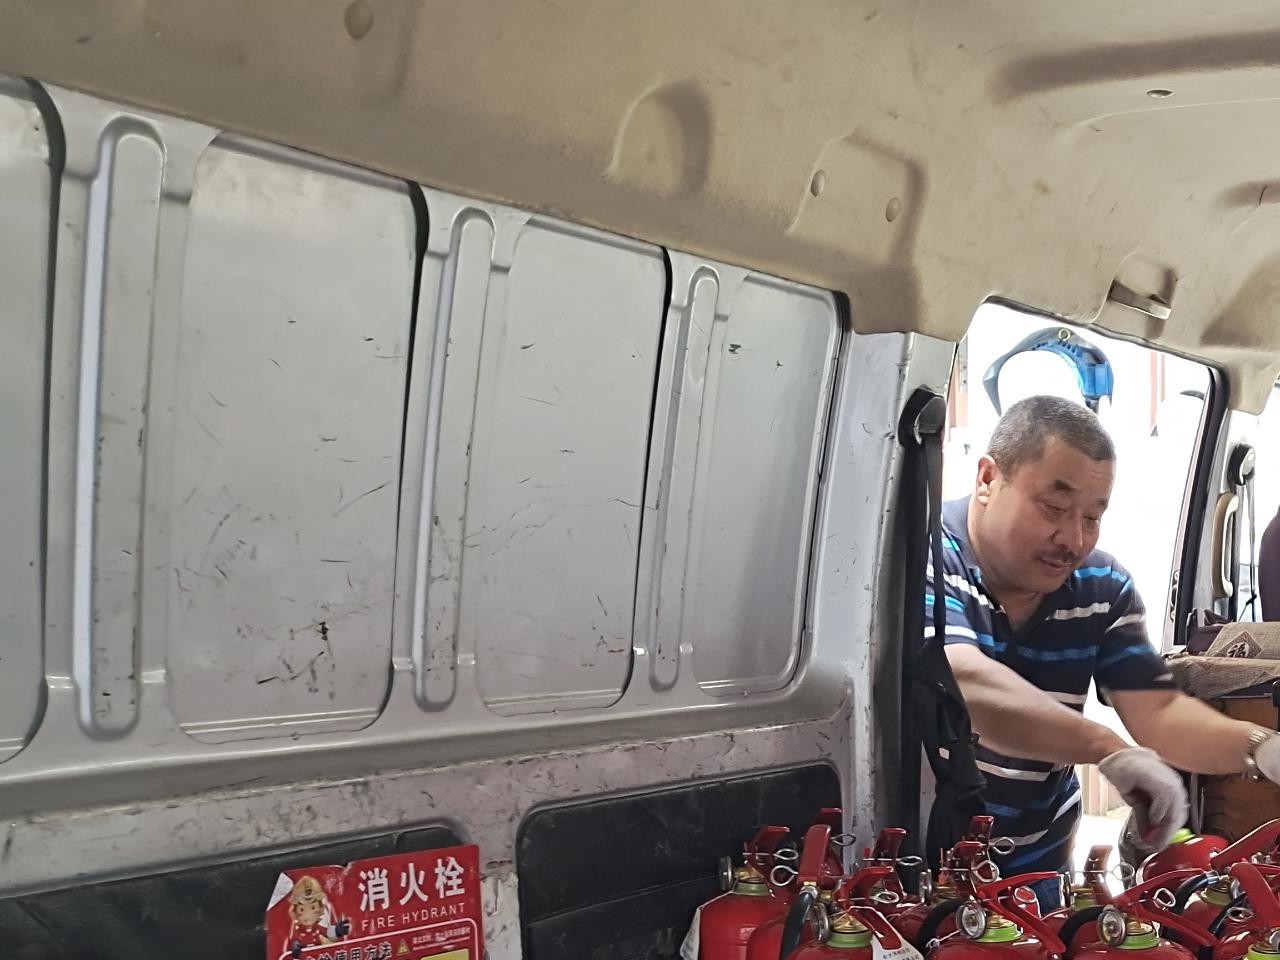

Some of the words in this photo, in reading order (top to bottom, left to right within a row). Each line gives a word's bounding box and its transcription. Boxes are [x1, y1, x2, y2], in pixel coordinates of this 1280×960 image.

[358, 856, 465, 912] 消火栓
[361, 914, 395, 932] FIRE
[402, 903, 465, 924] HYDRANT
